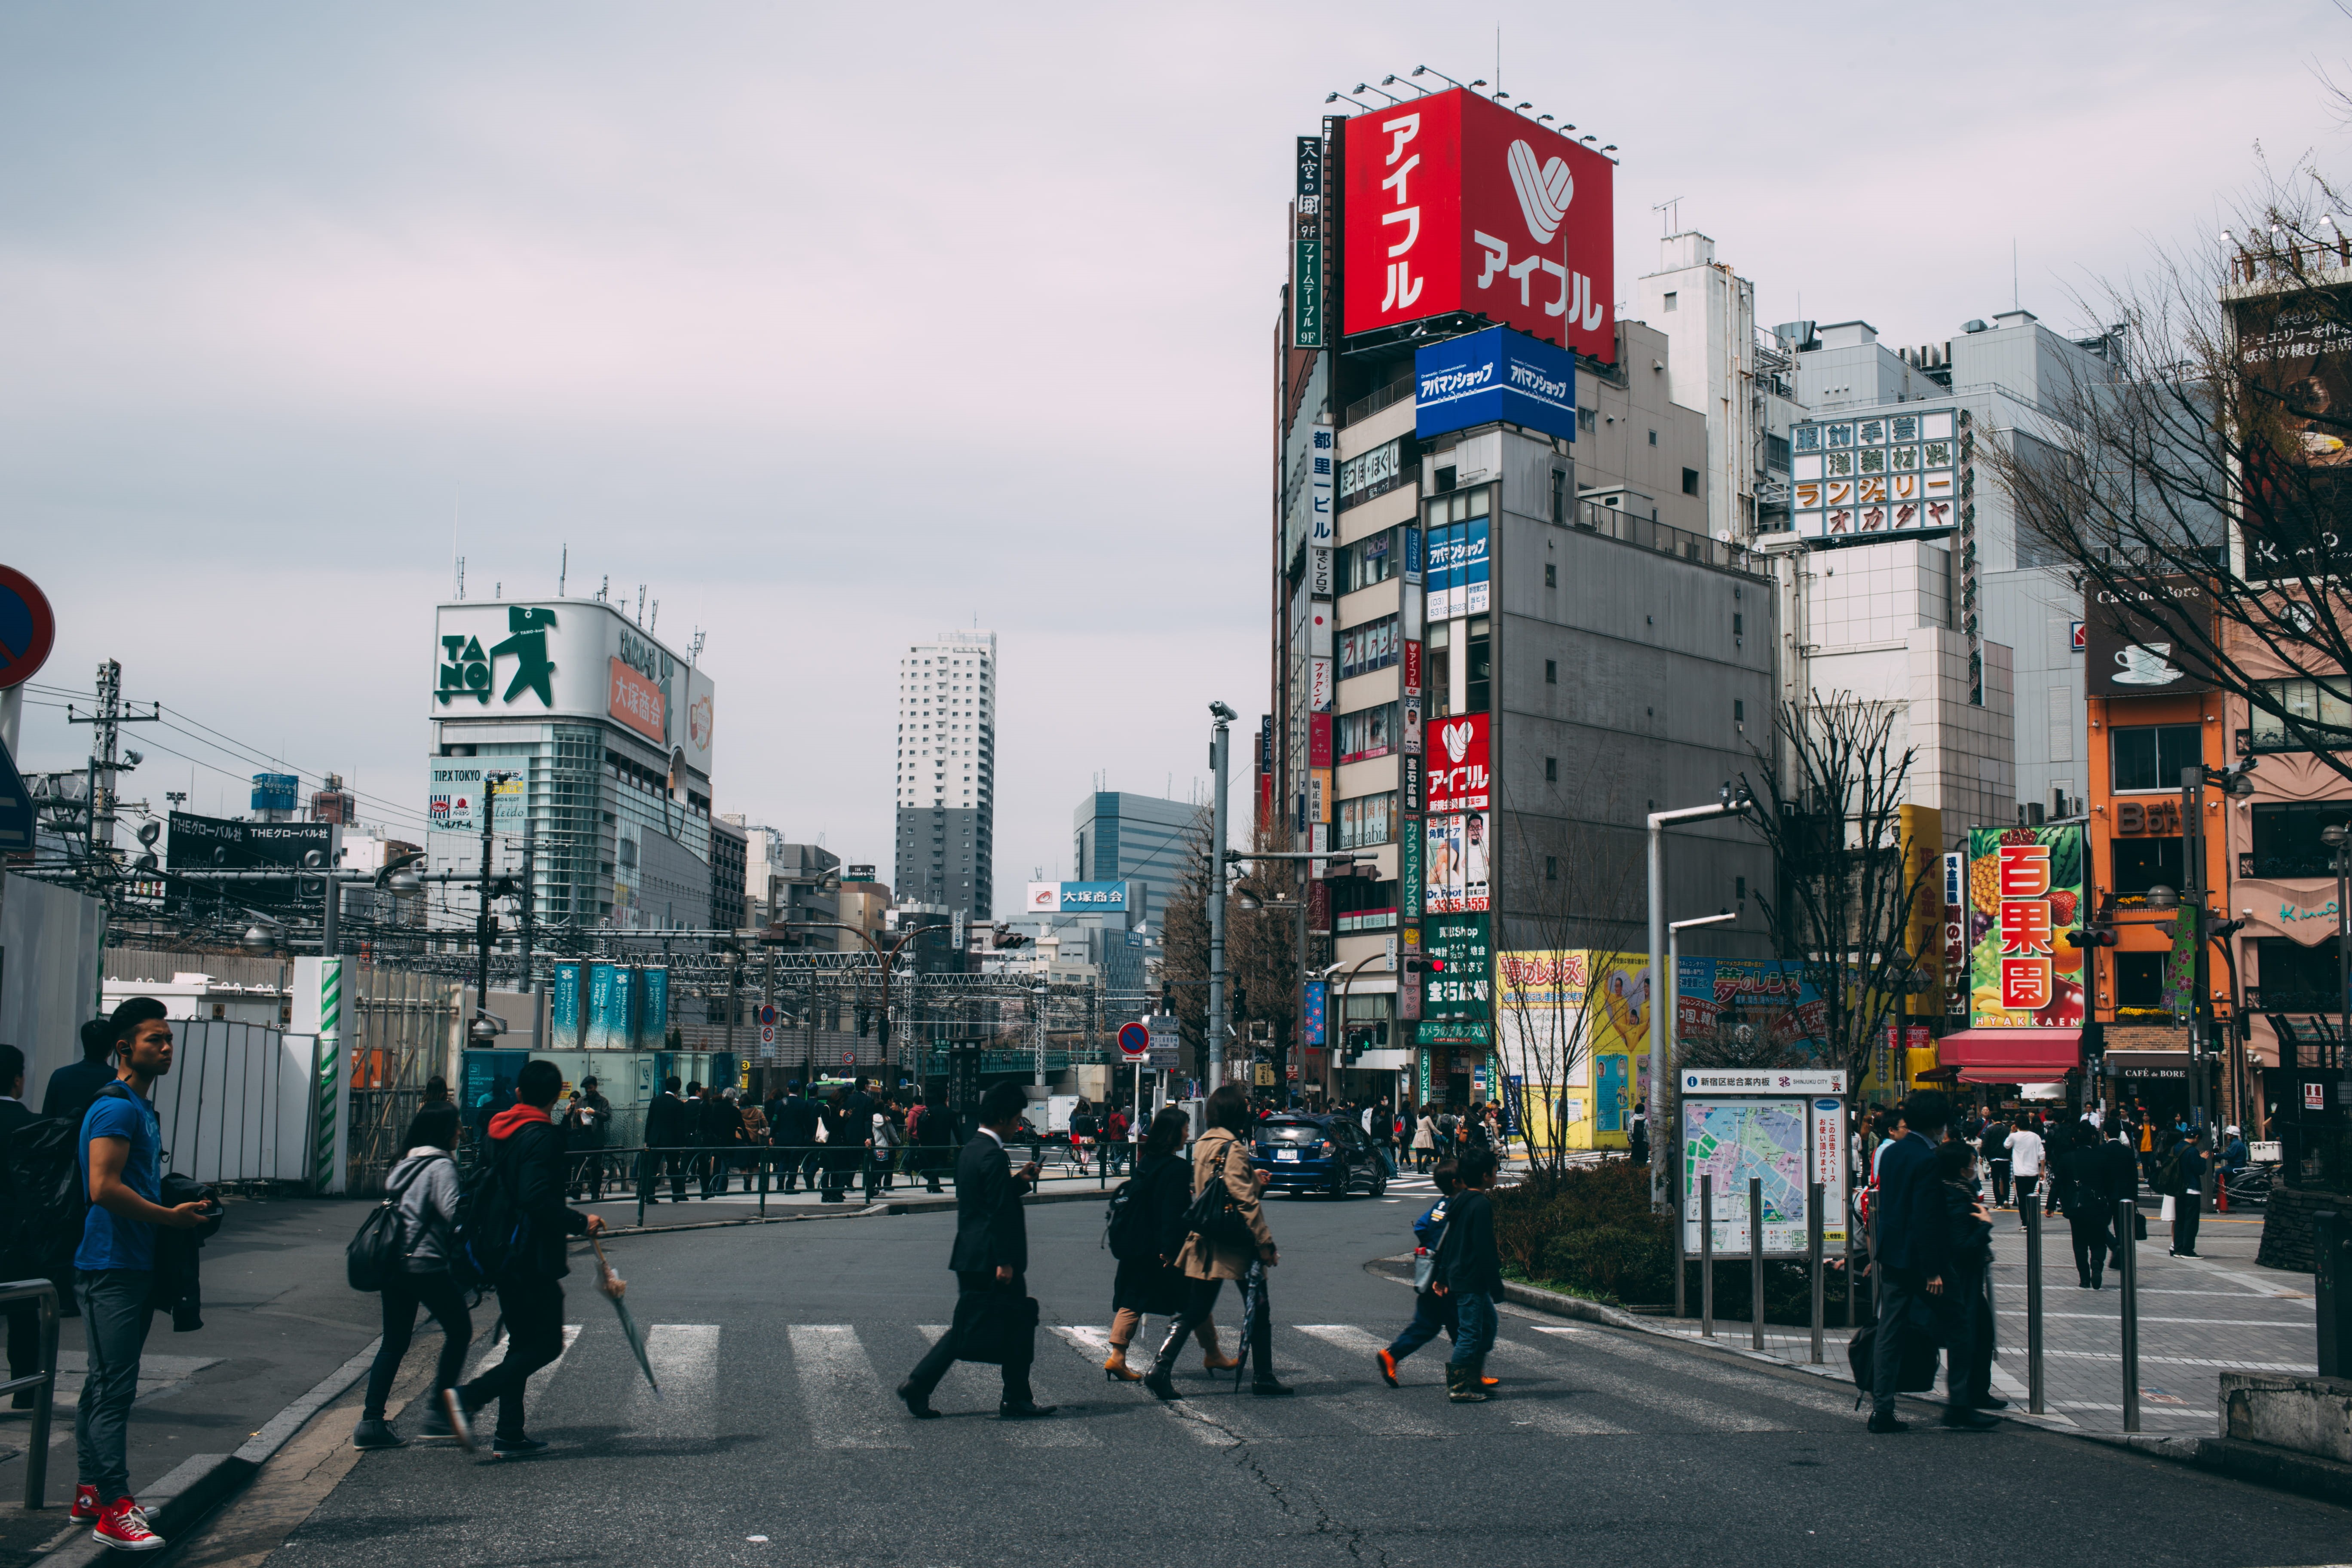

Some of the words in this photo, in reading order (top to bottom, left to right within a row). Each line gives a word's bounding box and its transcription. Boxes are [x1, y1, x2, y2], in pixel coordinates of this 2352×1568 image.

[1381, 112, 1423, 313] アイフル
[1302, 243, 1315, 328] ファームテーブル
[1474, 229, 1603, 331] アイフル
[1301, 332, 1316, 344] 9F
[1421, 370, 1438, 379] Dramatic
[1438, 363, 1467, 375] Communication
[1510, 357, 1525, 366] Dramatic
[1421, 361, 1494, 398] アパマンショップ
[1511, 365, 1567, 398] アパマンショップ
[1795, 417, 1916, 450] 服飾手芸
[1828, 443, 1950, 475] 洋装材料
[1797, 475, 1951, 506] ランジェリー
[1829, 502, 1950, 533] オカダヤ
[1430, 537, 1486, 565] アパマンショップ
[1316, 549, 1328, 593] ほぐしアロマ
[1430, 597, 1444, 606] (03)
[1430, 603, 1466, 616] 53122623
[1470, 595, 1486, 604] 当ビル
[442, 635, 487, 661] TA
[440, 662, 489, 689] NO
[616, 676, 661, 728] 大塚商会
[1405, 698, 1421, 707] 足つぼ
[1311, 715, 1320, 723] 5F
[454, 769, 481, 782] TOKYO
[1407, 758, 1418, 808] 宝石広場
[1428, 764, 1489, 795] アイフル
[1311, 780, 1320, 820] 矯正歯科
[2146, 799, 2176, 812] café
[172, 818, 242, 842] THEグローバル社
[250, 828, 328, 839] THEグローバル社
[1428, 827, 1461, 840] 角質ケア
[1429, 816, 1460, 828] 足つぼ
[1406, 821, 1418, 916] カメラのアルプス堂
[1062, 891, 1123, 903] 大塚商会
[1999, 844, 2053, 1010] 百果園
[1428, 980, 1489, 1002] 宝石広場
[1712, 967, 1802, 1004] 夢のレンズ
[598, 983, 607, 1023] SMOKING
[1735, 995, 1798, 1005] 関東、関西、海外から当ビへ
[1418, 1025, 1487, 1039] カメラのアルプス堂
[1975, 1016, 2080, 1026] HYAKKAEN
[1700, 1077, 1770, 1087] 新宿区総合案内板
[2125, 1067, 2150, 1077] CAFÉ
[2159, 1069, 2186, 1078] BORE
[1828, 1118, 1837, 1182] この広告スペース
